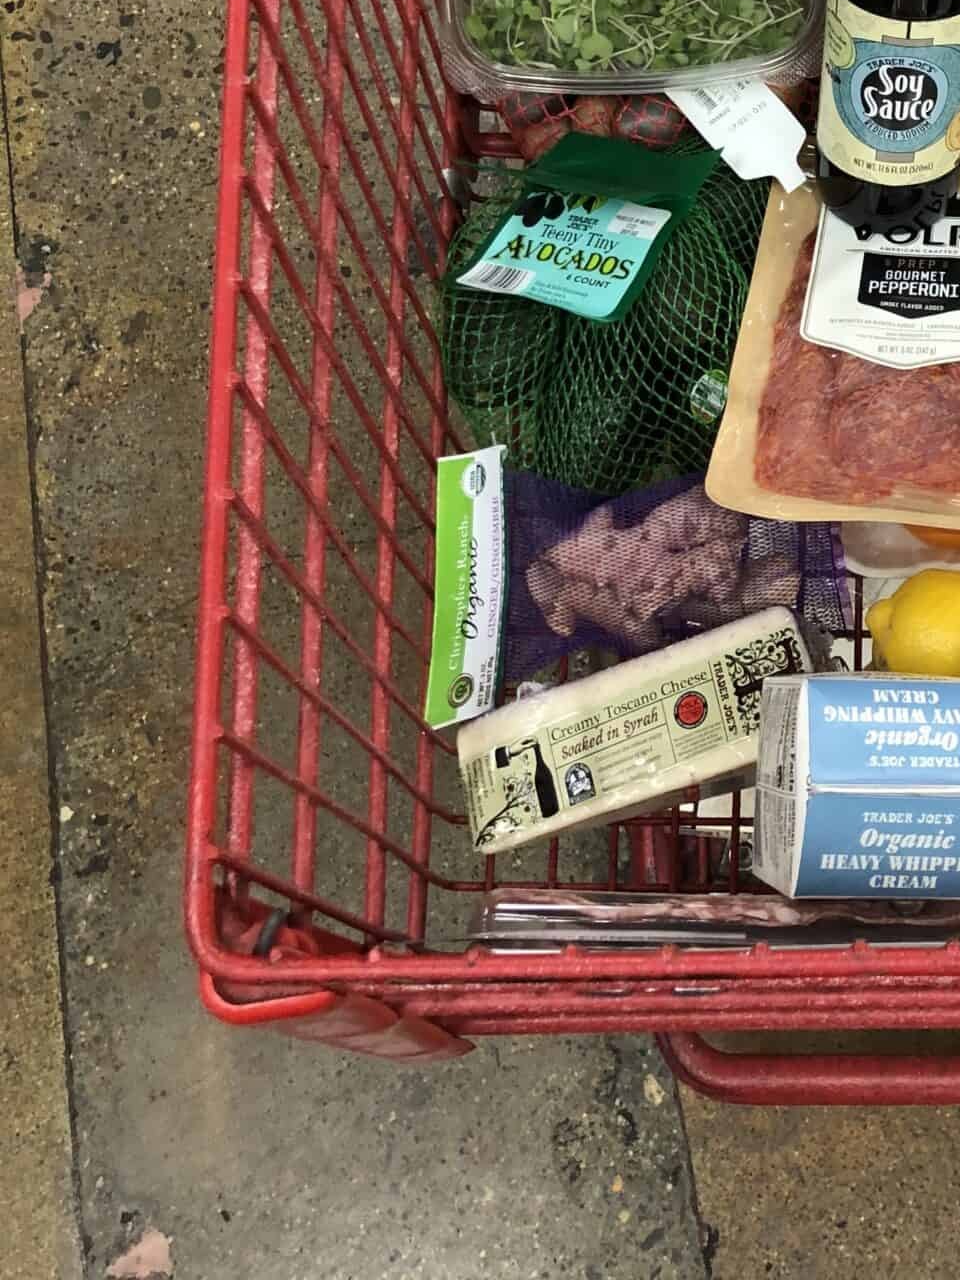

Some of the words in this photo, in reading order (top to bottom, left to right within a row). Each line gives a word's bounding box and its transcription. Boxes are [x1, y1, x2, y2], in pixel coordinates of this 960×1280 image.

[866, 58, 905, 70] TRADER
[908, 60, 935, 73] JOE'S
[878, 65, 925, 101] Soy
[864, 86, 935, 121] Sauce
[864, 119, 899, 139] REDUCED
[900, 120, 931, 139] SODIUM
[542, 223, 584, 246] Teeny
[586, 231, 620, 254] Tiny
[493, 234, 637, 280] AVOCADOS
[574, 275, 612, 288] COUNT
[885, 270, 946, 281] GOURMET
[868, 280, 960, 298] PEPPERONI
[880, 300, 900, 308] SMOKE
[901, 302, 923, 310] FLAVOR
[488, 497, 500, 638] GINGER/GINGEMBRE
[461, 538, 485, 639] Organic
[712, 660, 730, 701] TRADER
[722, 700, 738, 735] JOE'S
[872, 689, 940, 704] CREAM
[551, 715, 601, 743] Creamy
[604, 691, 659, 717] Toscano
[660, 670, 708, 697] Cheese
[823, 707, 931, 723] WHIPPING
[561, 731, 605, 759] Soaked
[606, 724, 621, 740] in
[623, 708, 660, 736] Syrah
[865, 726, 959, 751] Organic
[869, 755, 906, 767] JOE'S
[910, 756, 960, 768] TRADER
[863, 812, 912, 824] TRADER
[917, 813, 954, 825] JOE'S
[860, 828, 956, 853] Organic
[820, 853, 884, 870] HEAVY
[869, 874, 938, 889] CREAM
